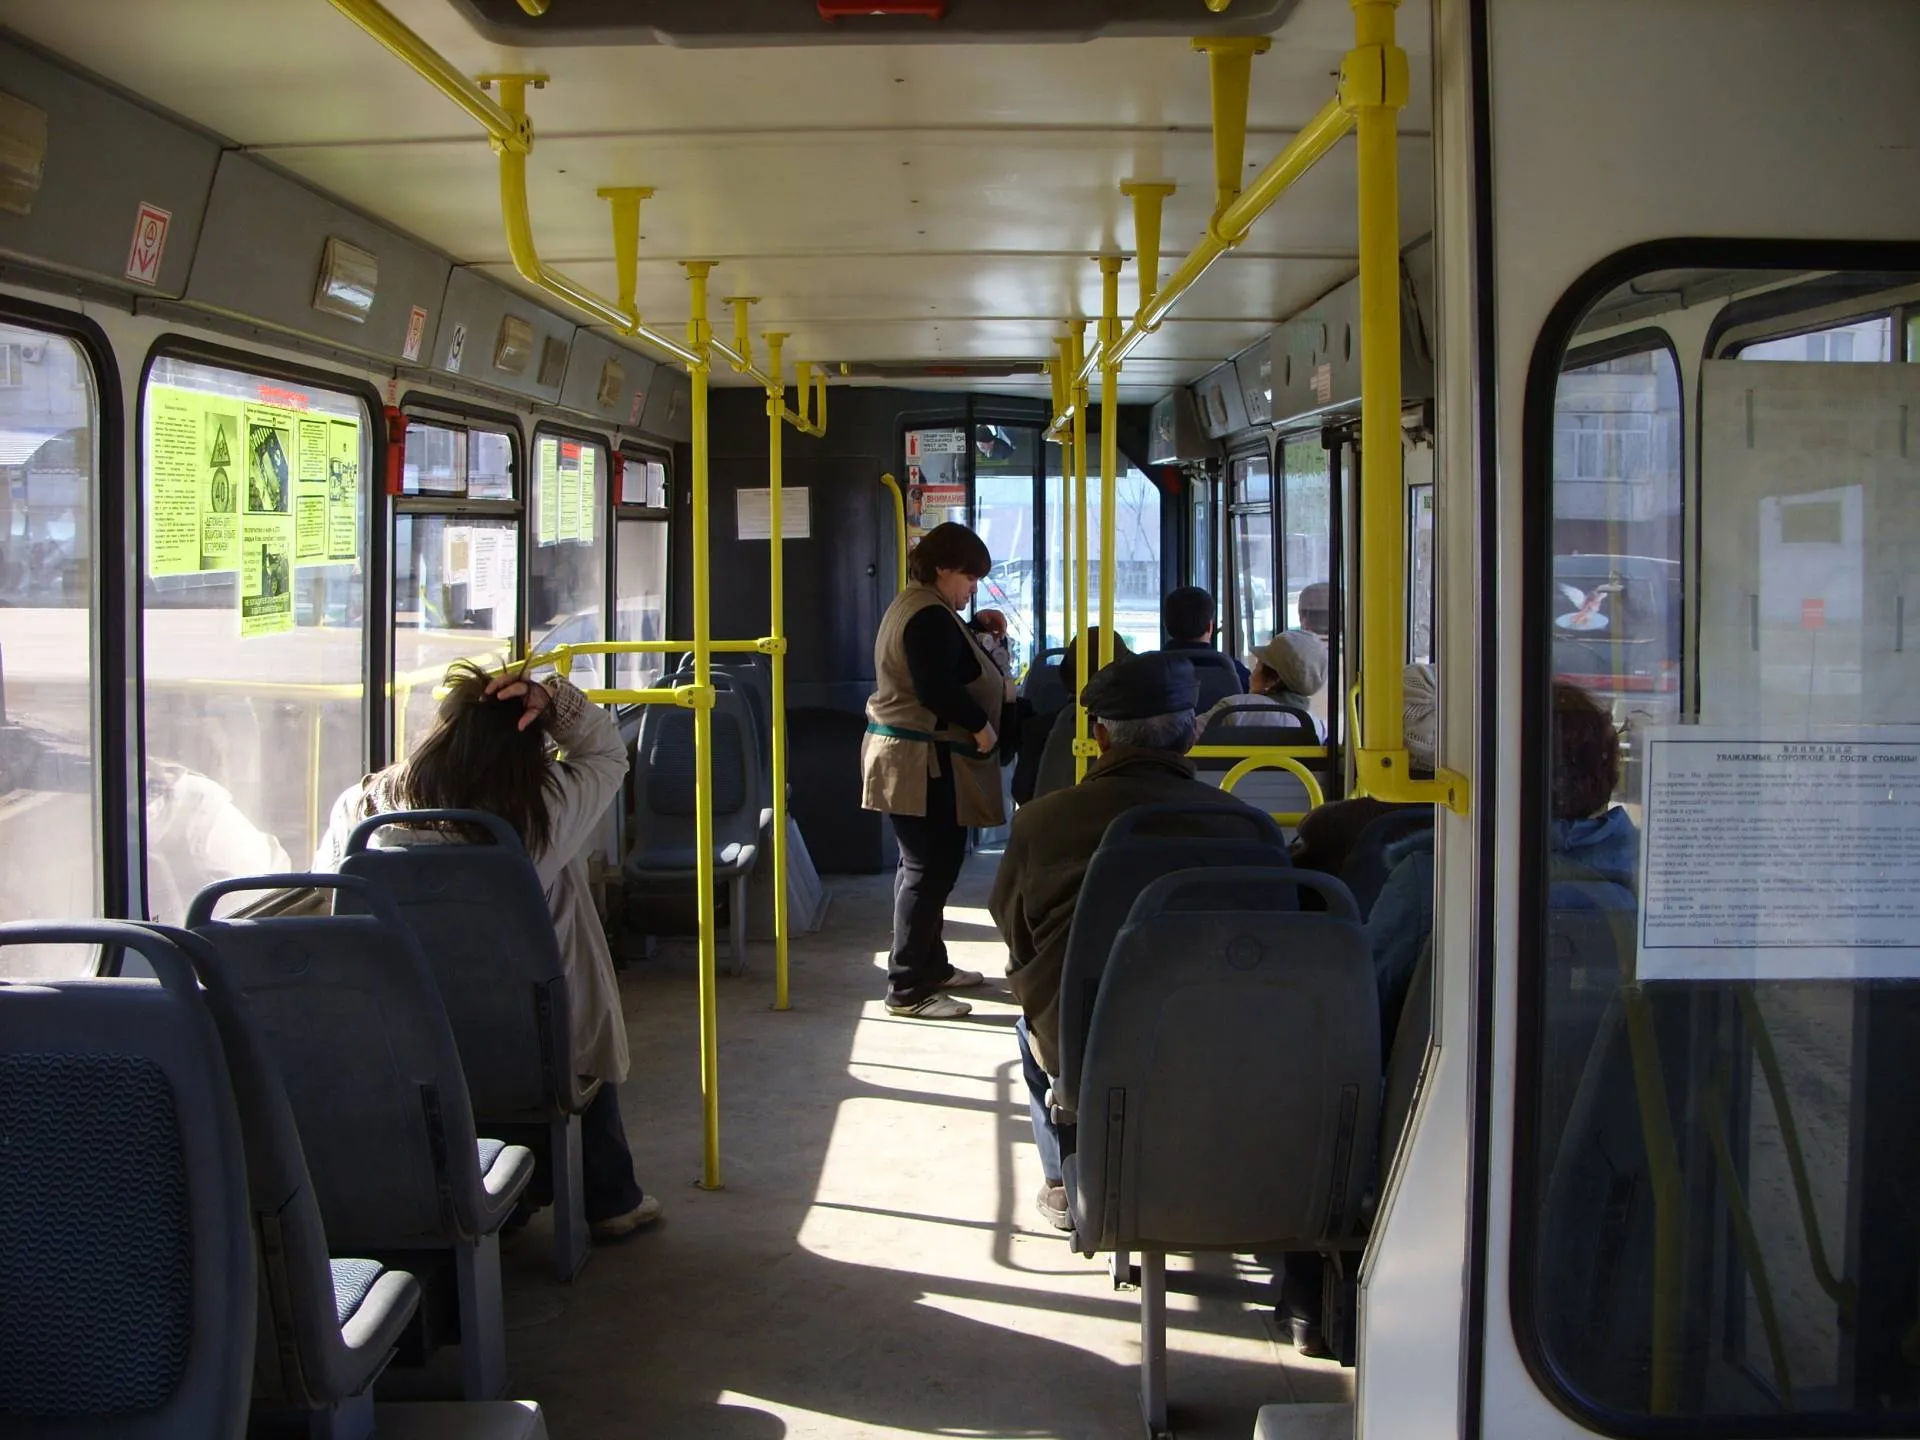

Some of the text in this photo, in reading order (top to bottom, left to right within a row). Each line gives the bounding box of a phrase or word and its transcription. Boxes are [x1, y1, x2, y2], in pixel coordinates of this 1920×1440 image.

[215, 482, 225, 503] 40
[1716, 754, 1770, 762] УВАЖАЕМЫЕ
[1777, 754, 1823, 762] ГОРОЖАНЕ
[1840, 754, 1867, 763] ГОСТИ
